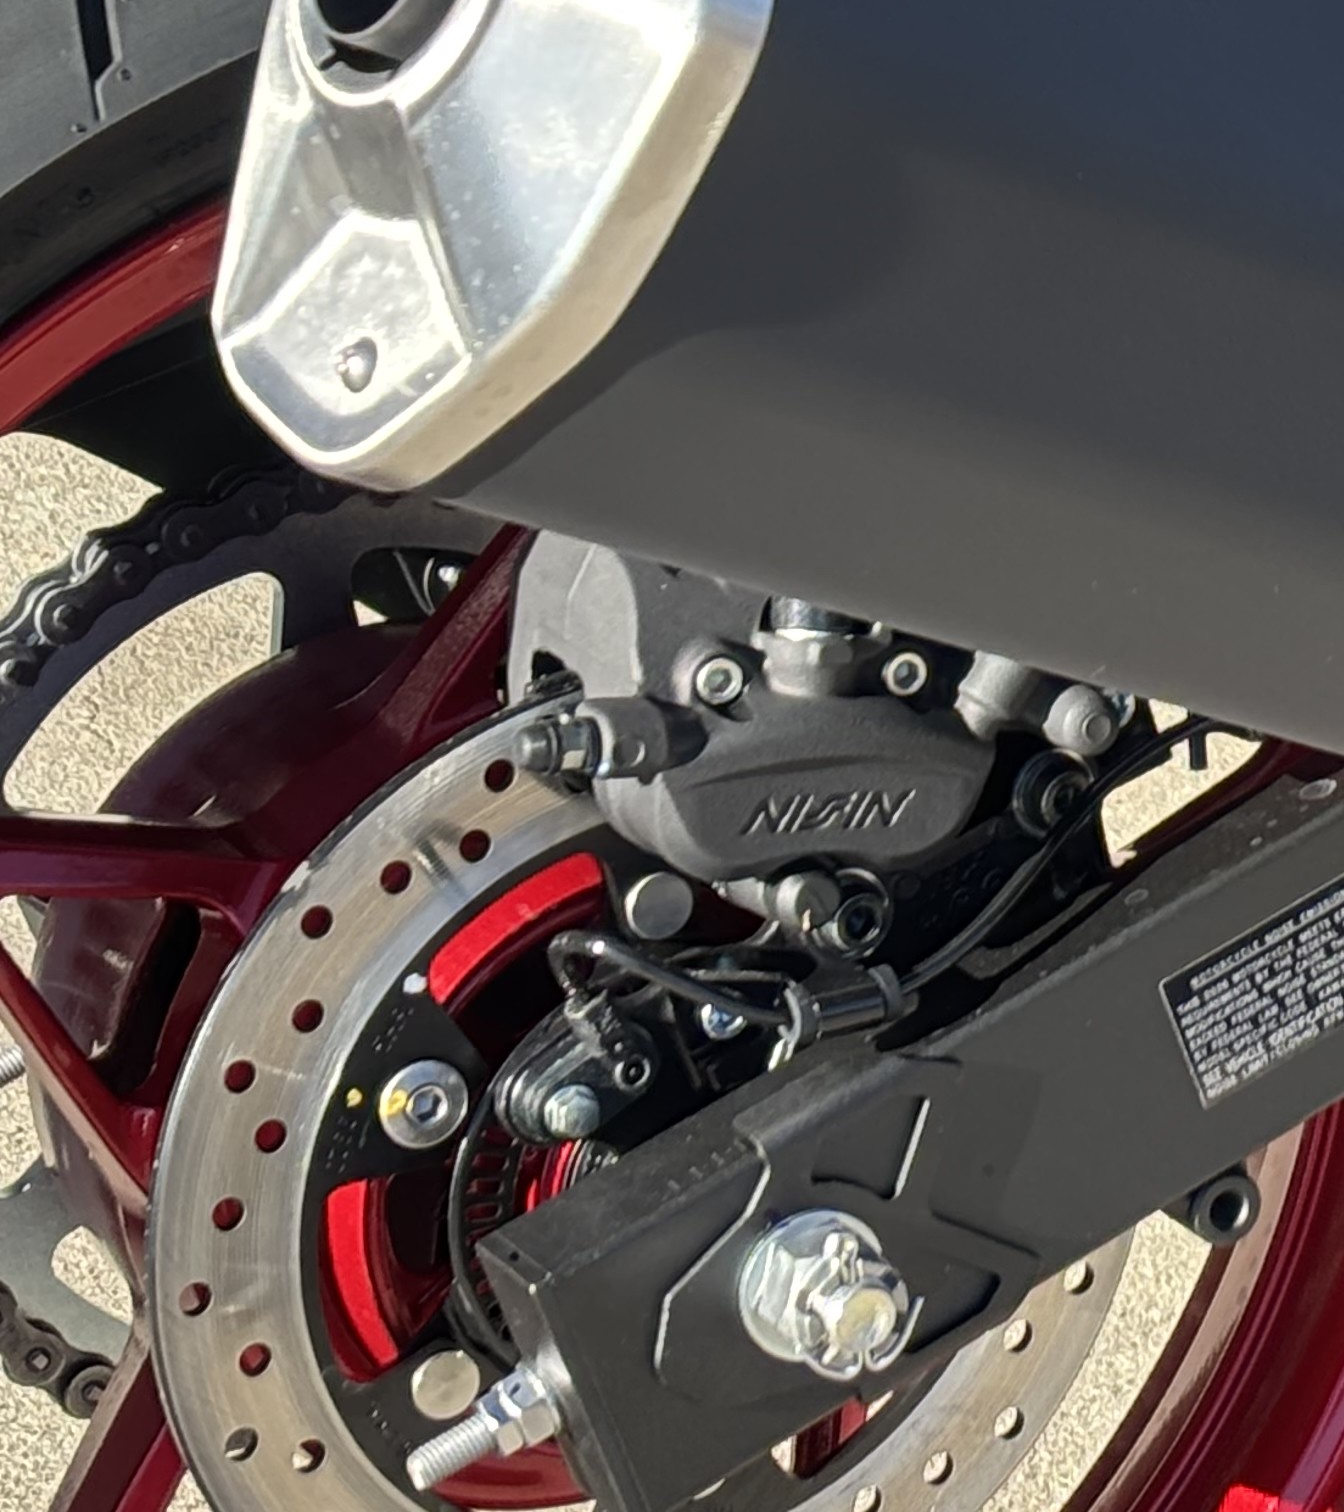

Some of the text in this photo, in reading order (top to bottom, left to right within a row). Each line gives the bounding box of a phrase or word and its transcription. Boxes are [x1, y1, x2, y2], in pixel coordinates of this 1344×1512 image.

[1177, 995, 1198, 1016] THIS
[1232, 938, 1292, 984] MOTORCYCLE
[1299, 916, 1328, 943] MEETS
[1182, 978, 1249, 1028] REQUIREMENTS
[1255, 966, 1268, 984] BY
[1275, 953, 1289, 971] THE
[1296, 925, 1336, 959] FEDERAL
[1191, 939, 1258, 988] MOTORCYCLE
[1264, 918, 1292, 944] NOISE
[1300, 887, 1344, 923] EMISSION
[1186, 987, 1256, 1039] MODIFICATIONS
[1263, 967, 1290, 993] WHICH
[1296, 946, 1324, 973] CAUSE
[1190, 1021, 1225, 1051] EXCEED
[1232, 993, 1270, 1026] FEDERAL
[1278, 973, 1304, 998] NOISE
[1194, 1046, 1206, 1062] BY
[1213, 1019, 1251, 1051] FEDERAL
[1286, 988, 1301, 1007] SEE
[1199, 1046, 1229, 1074] MODEL
[1234, 1018, 1275, 1052] SPECIFIC
[1280, 1000, 1304, 1024] CODE
[1204, 1066, 1219, 1088] SEE
[1226, 1040, 1263, 1074] VEHICLE
[1270, 992, 1341, 1048] IDENTIFICATION
[1208, 1073, 1235, 1100] NOISE
